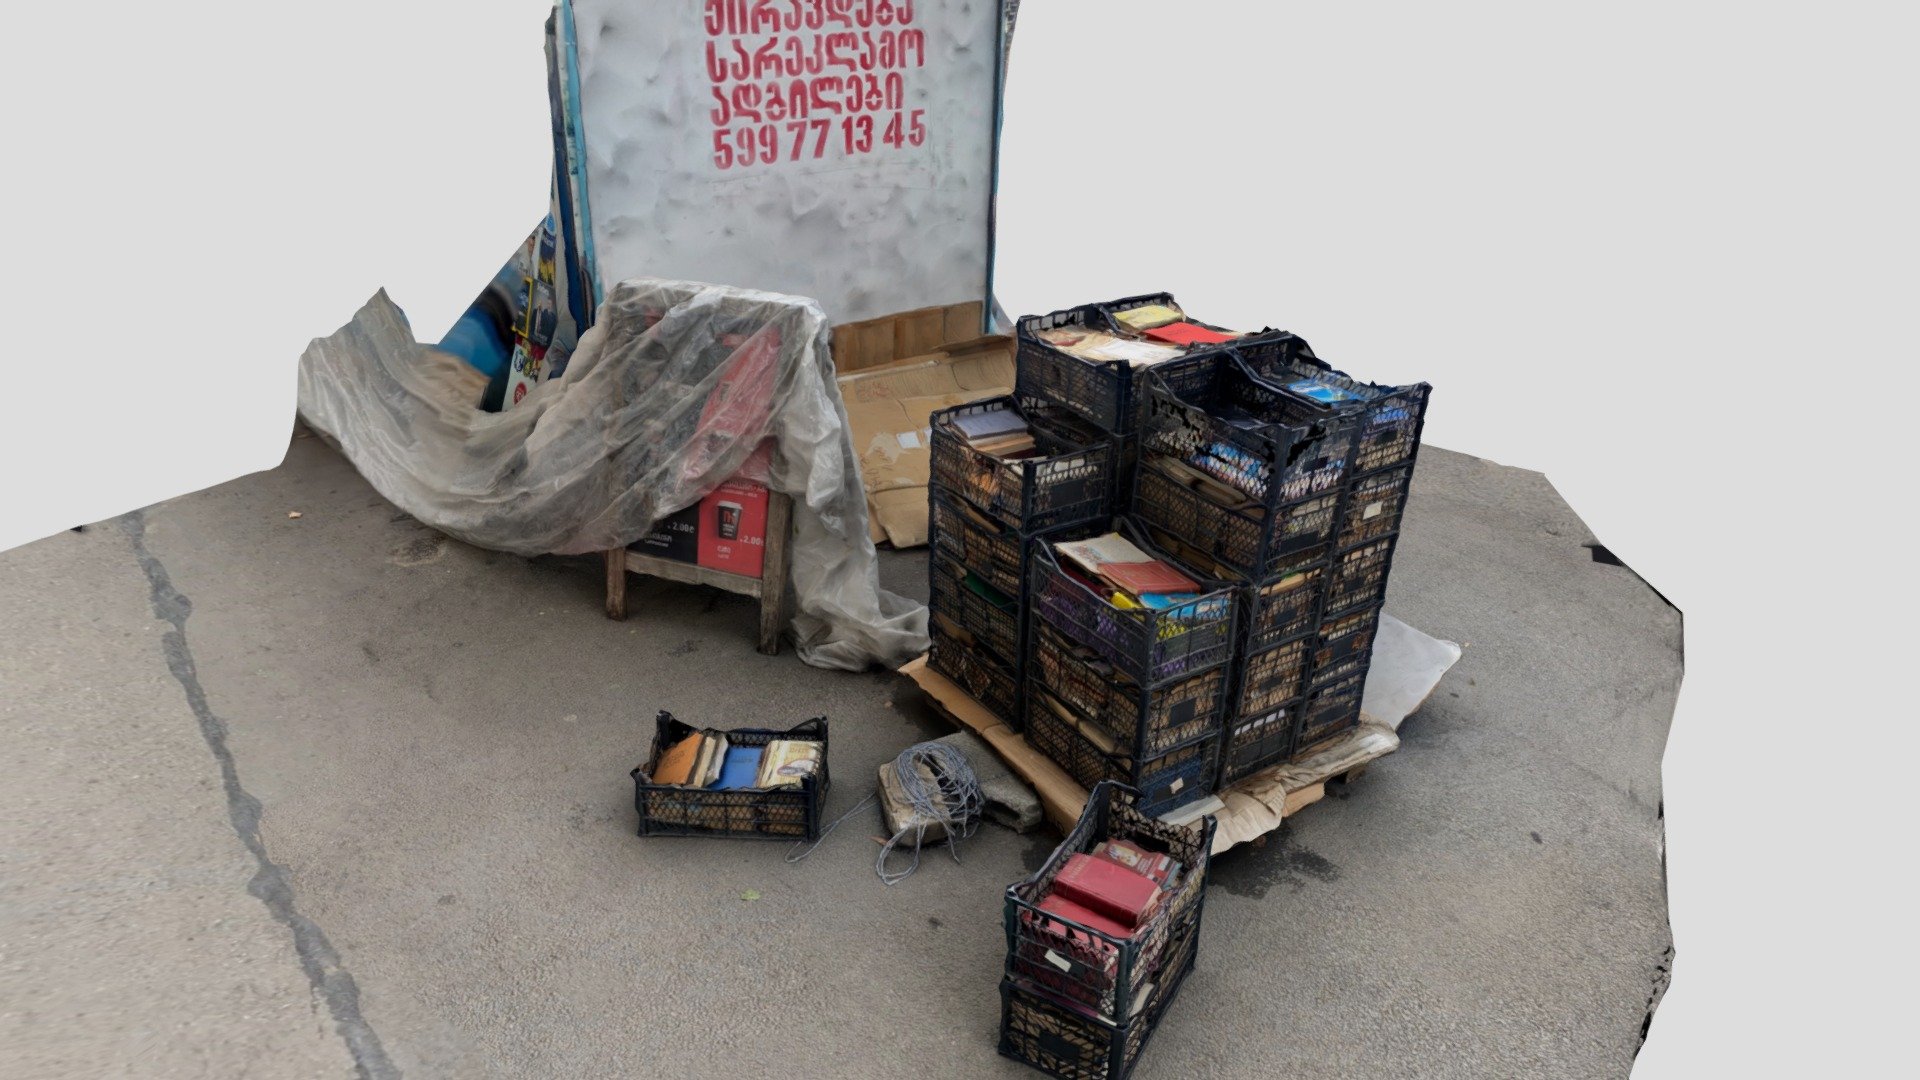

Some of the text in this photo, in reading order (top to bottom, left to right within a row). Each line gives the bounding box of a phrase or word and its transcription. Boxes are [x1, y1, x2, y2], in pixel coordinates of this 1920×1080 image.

[706, 29, 925, 83] სარეკლამო
[710, 72, 904, 127] ადგილები
[713, 109, 926, 170] 599 77 13 45
